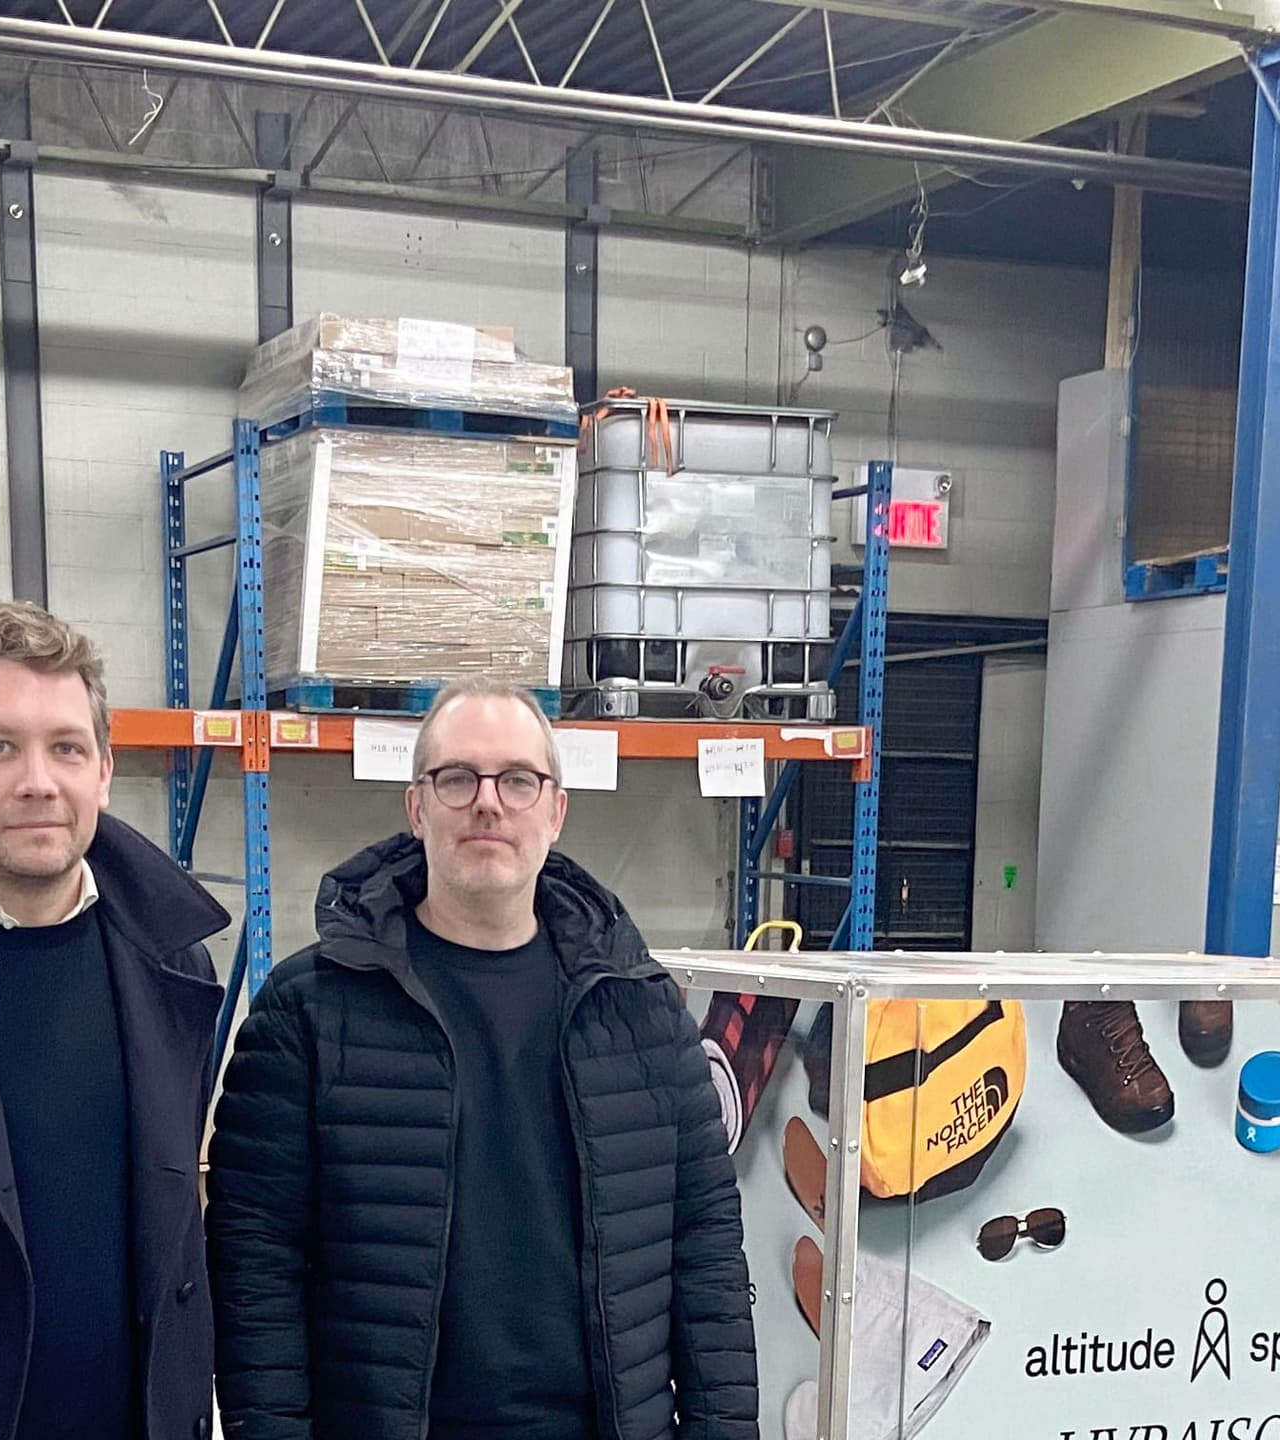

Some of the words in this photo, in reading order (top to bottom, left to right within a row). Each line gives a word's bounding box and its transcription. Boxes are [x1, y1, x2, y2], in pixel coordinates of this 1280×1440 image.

[951, 1078, 984, 1115] THE
[926, 1095, 985, 1151] NORTH
[946, 1112, 986, 1154] FACE
[1025, 1328, 1175, 1377] altitude
